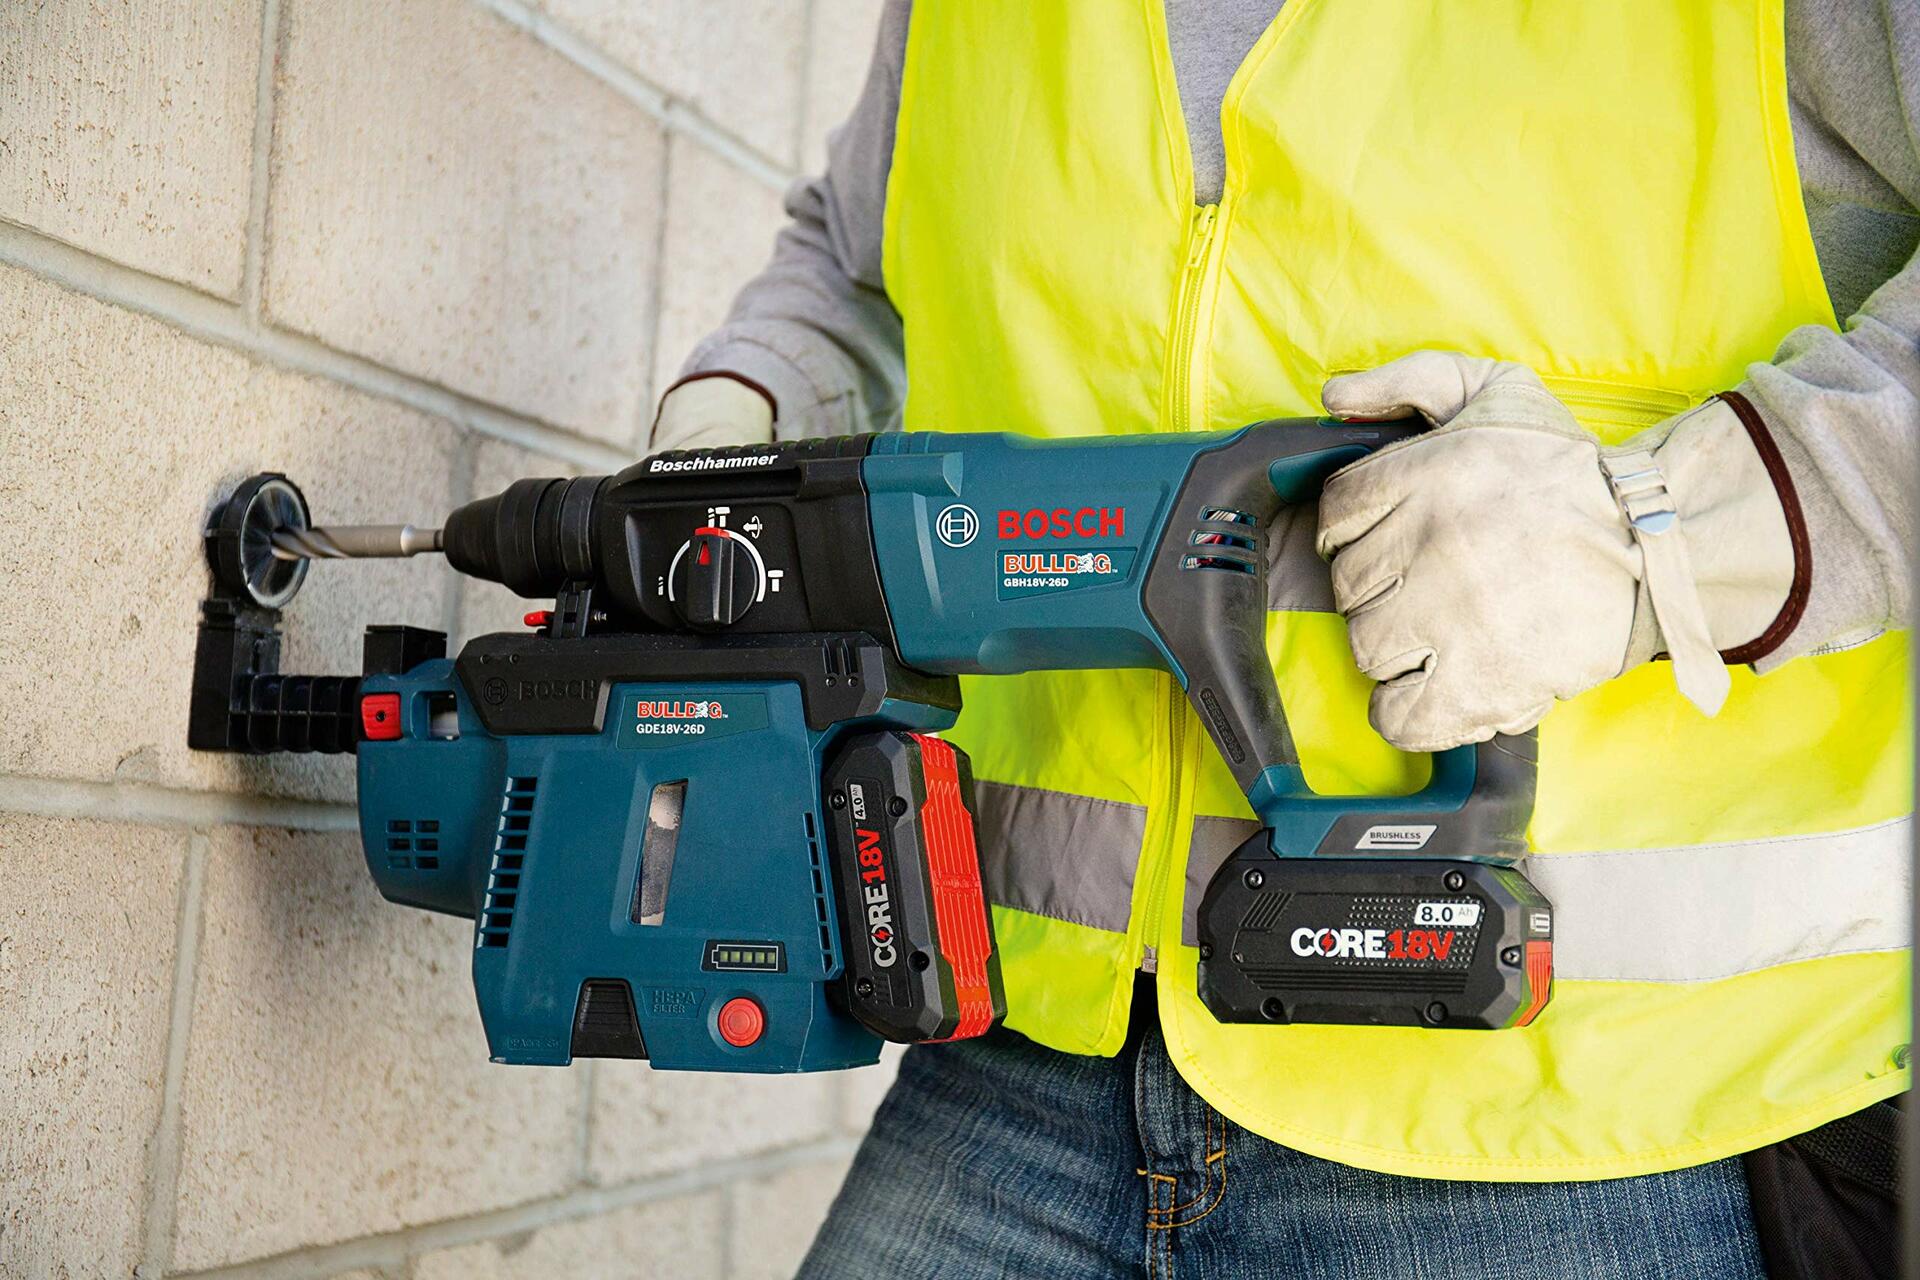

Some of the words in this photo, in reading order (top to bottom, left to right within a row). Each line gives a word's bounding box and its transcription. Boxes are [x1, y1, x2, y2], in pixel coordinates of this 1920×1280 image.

[649, 452, 778, 474] Boschhammer
[997, 507, 1125, 540] BOSCH
[1003, 553, 1112, 575] BULLDG
[1003, 577, 1069, 588] GBH18V-26D
[637, 701, 722, 719] BULLDG
[636, 723, 705, 735] GDE18V-26D
[854, 797, 864, 818] 4.0
[1369, 831, 1422, 840] BRUSHLESS
[1421, 906, 1454, 922] 8.0
